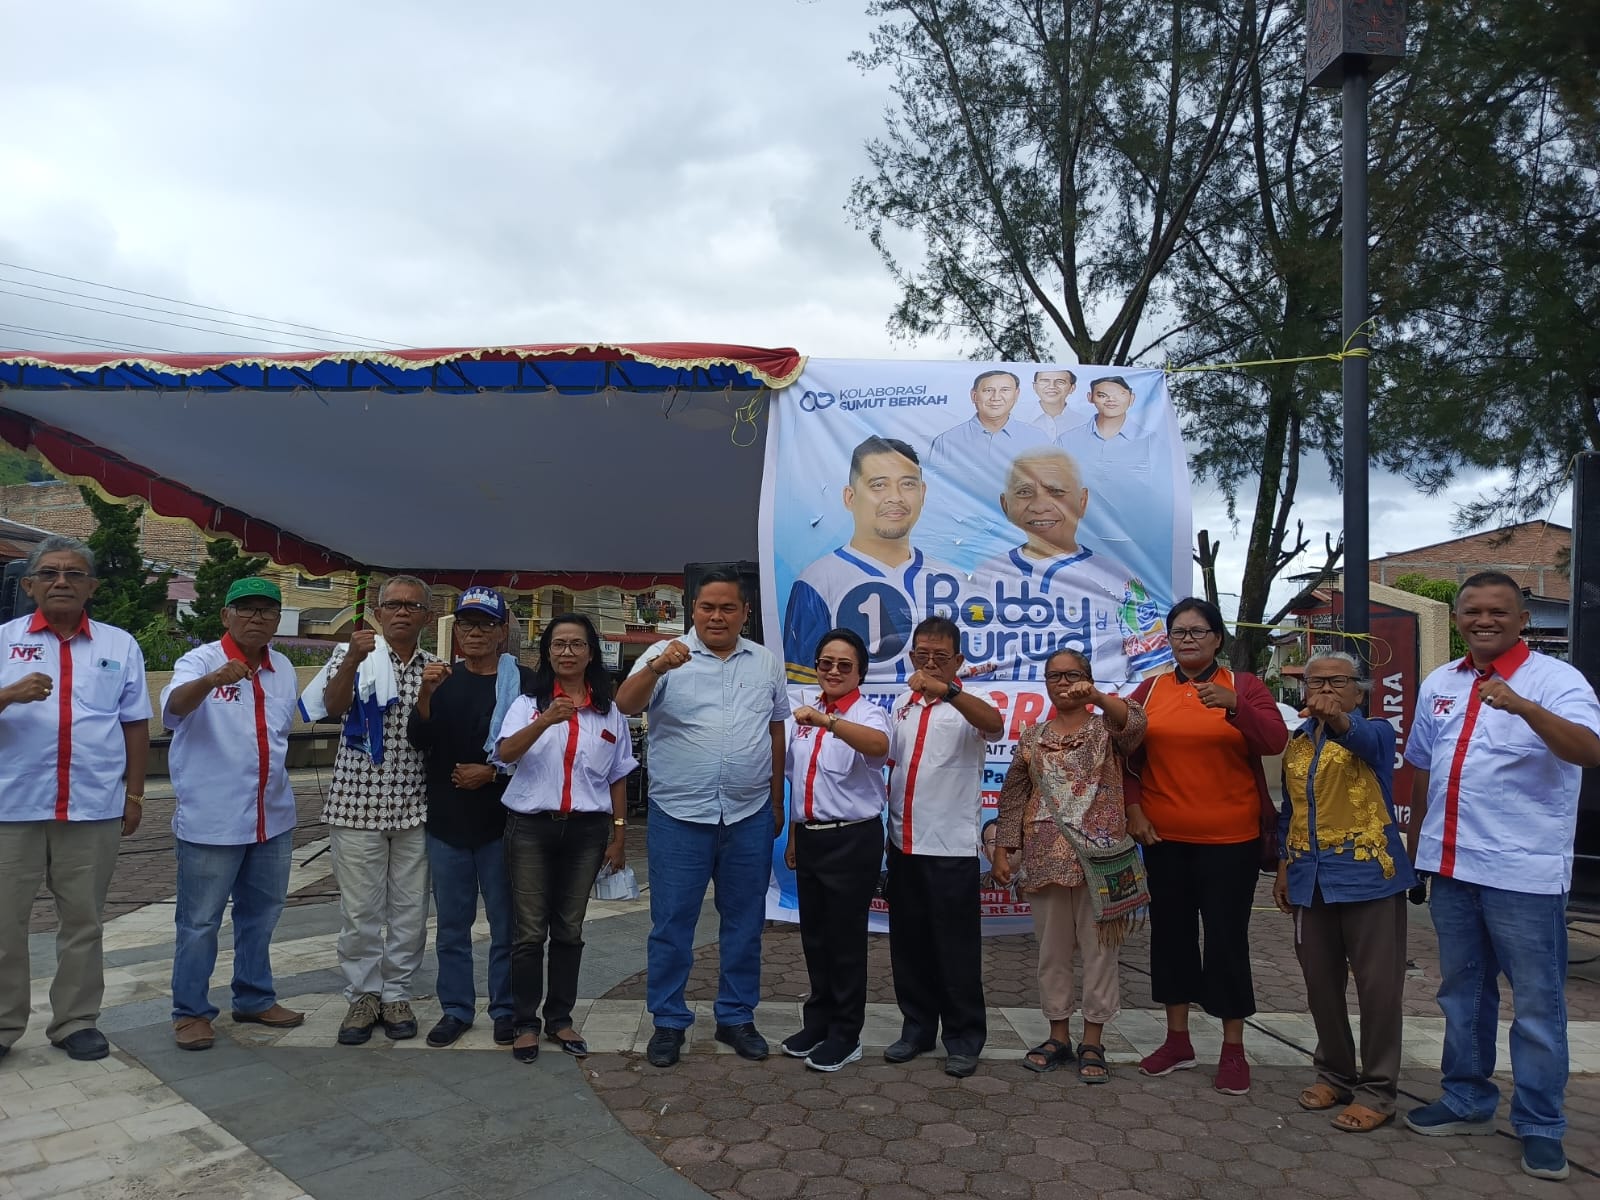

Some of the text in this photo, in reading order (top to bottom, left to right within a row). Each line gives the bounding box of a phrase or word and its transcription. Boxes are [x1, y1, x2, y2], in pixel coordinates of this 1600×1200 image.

[840, 385, 927, 400] KOLABORASI
[839, 395, 948, 411] SUMUT BERKAH
[926, 573, 1091, 629] Bobby
[857, 592, 882, 655] 1
[984, 770, 1006, 783] Pa
